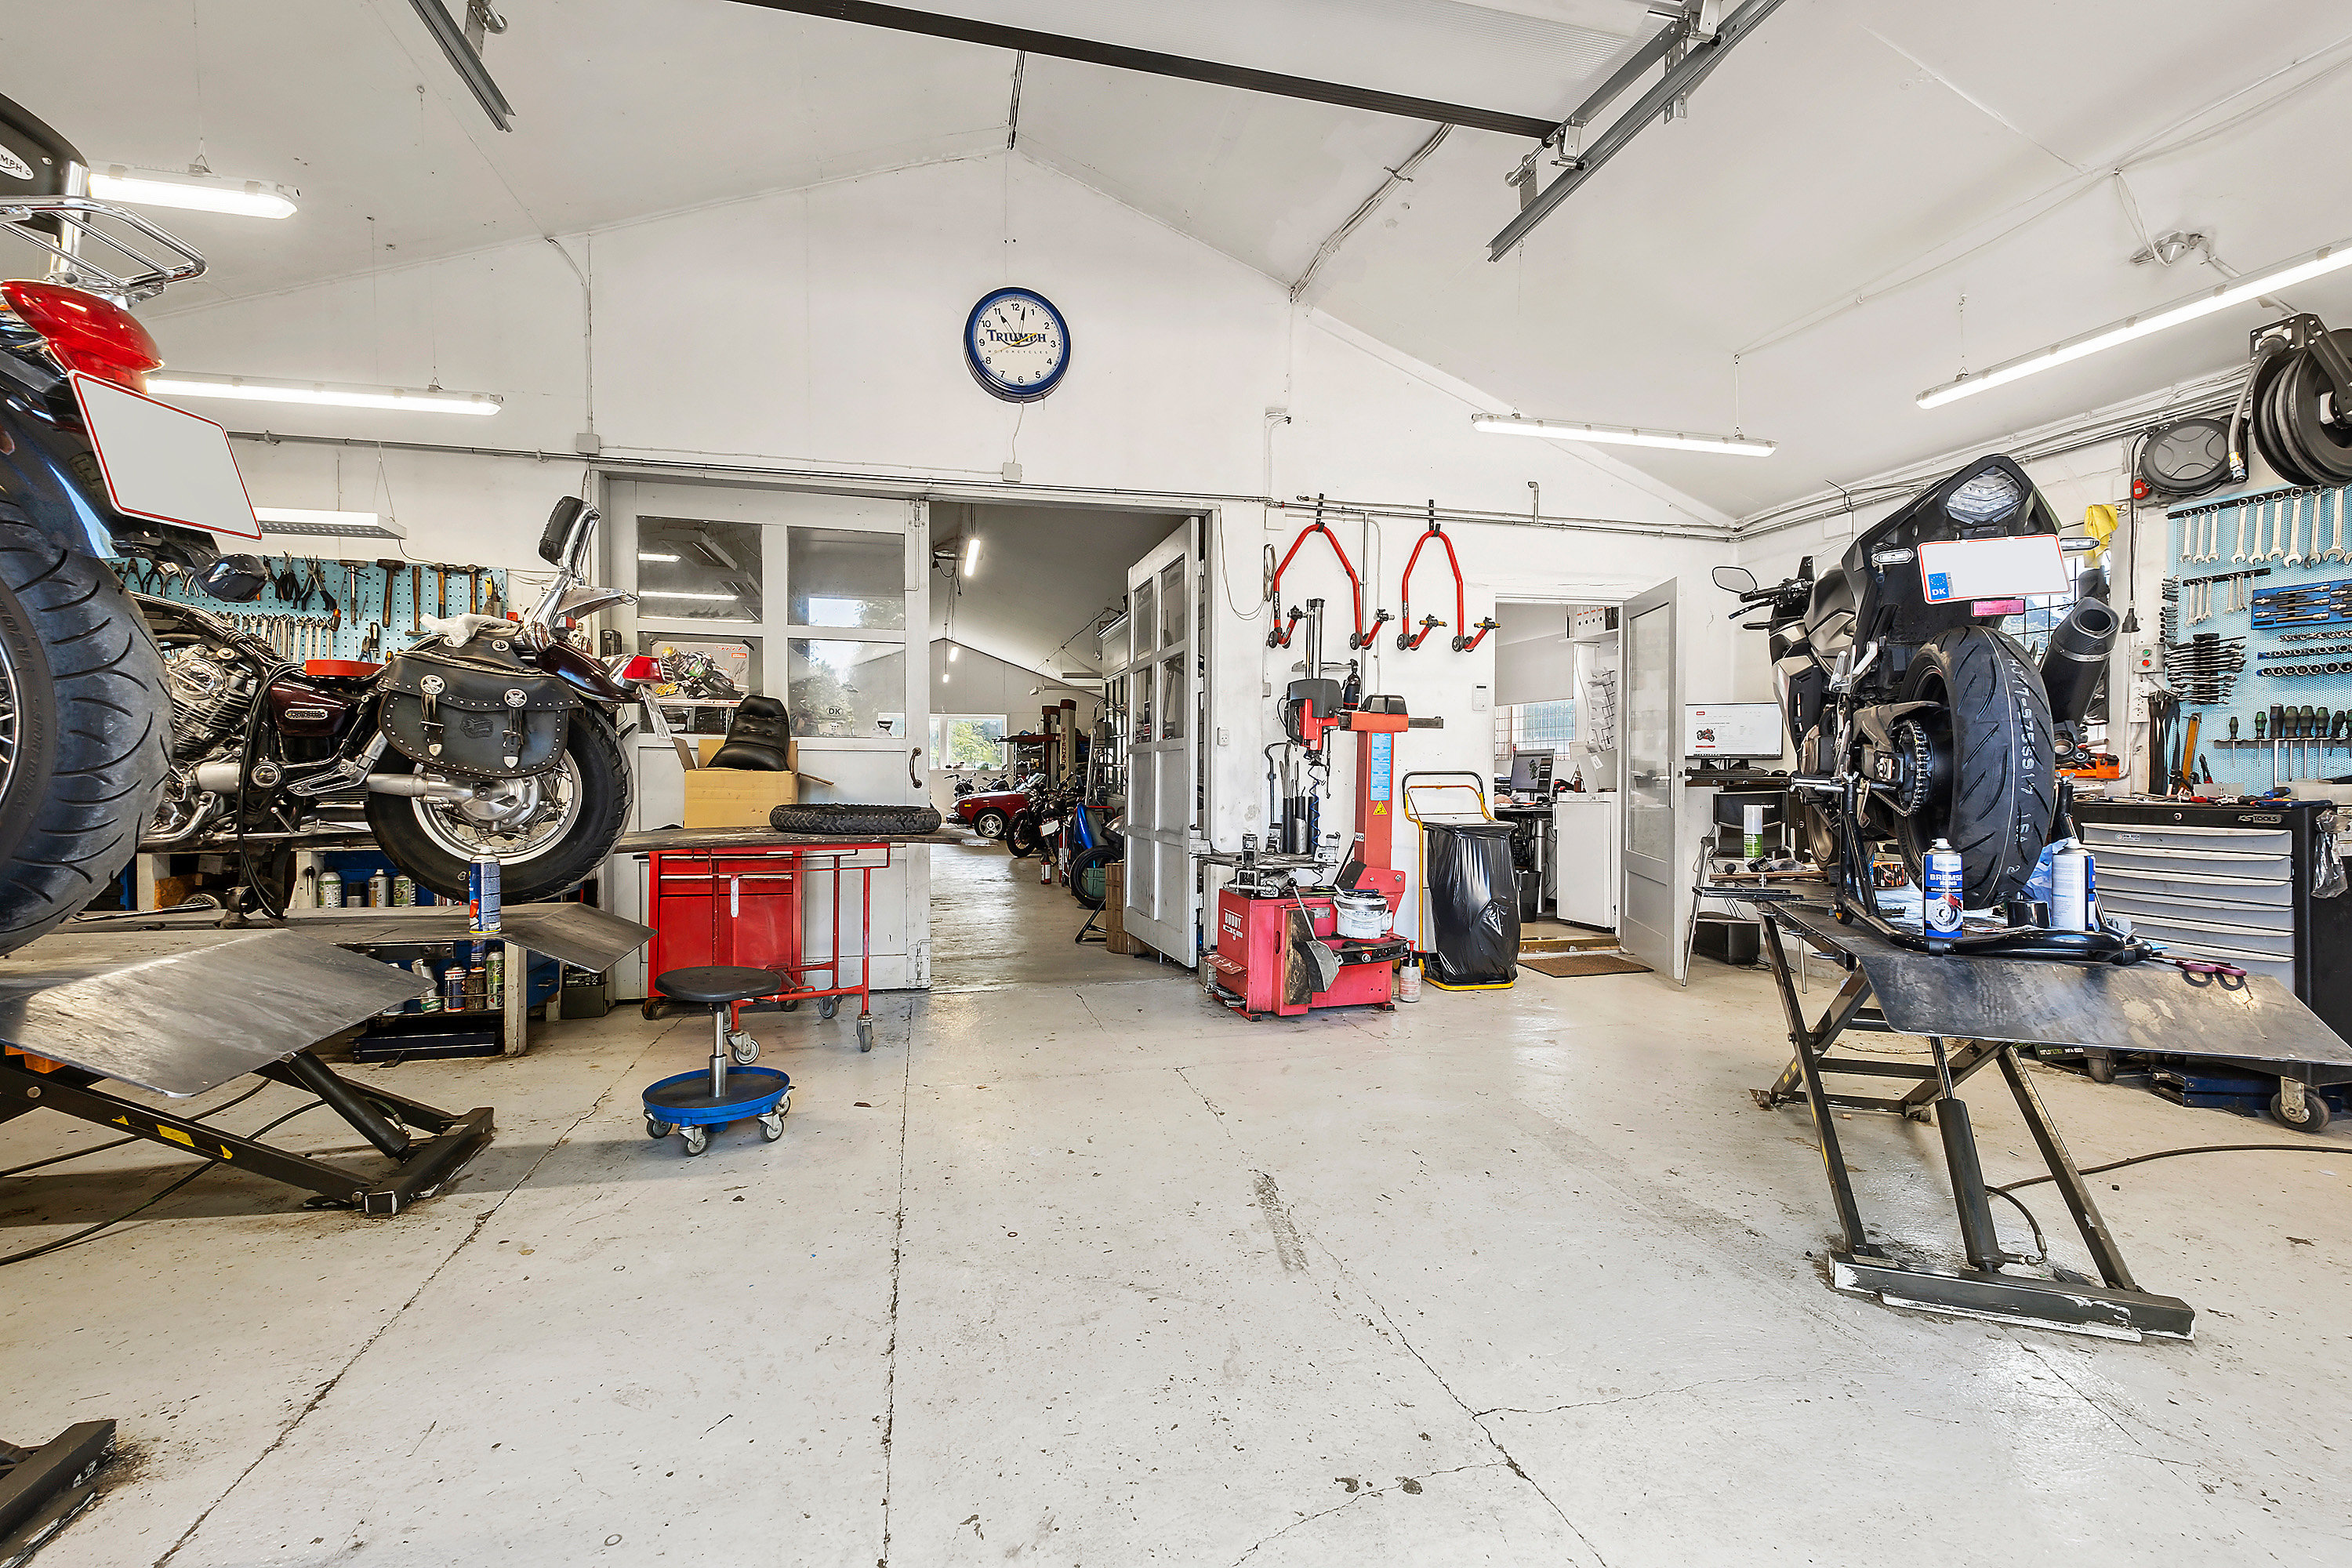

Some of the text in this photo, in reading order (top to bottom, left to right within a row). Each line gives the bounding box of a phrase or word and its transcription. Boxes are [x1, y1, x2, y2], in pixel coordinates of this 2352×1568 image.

[993, 307, 1001, 316] 11
[1011, 303, 1020, 311] 12
[1044, 321, 1050, 330] 2
[985, 328, 1047, 343] TRIUMPH
[979, 338, 985, 347] 9
[985, 356, 992, 365] 8
[1018, 376, 1024, 384] 6
[1931, 587, 1947, 596] DK
[1225, 912, 1242, 930] BUDDY
[1232, 928, 1236, 941] 5
